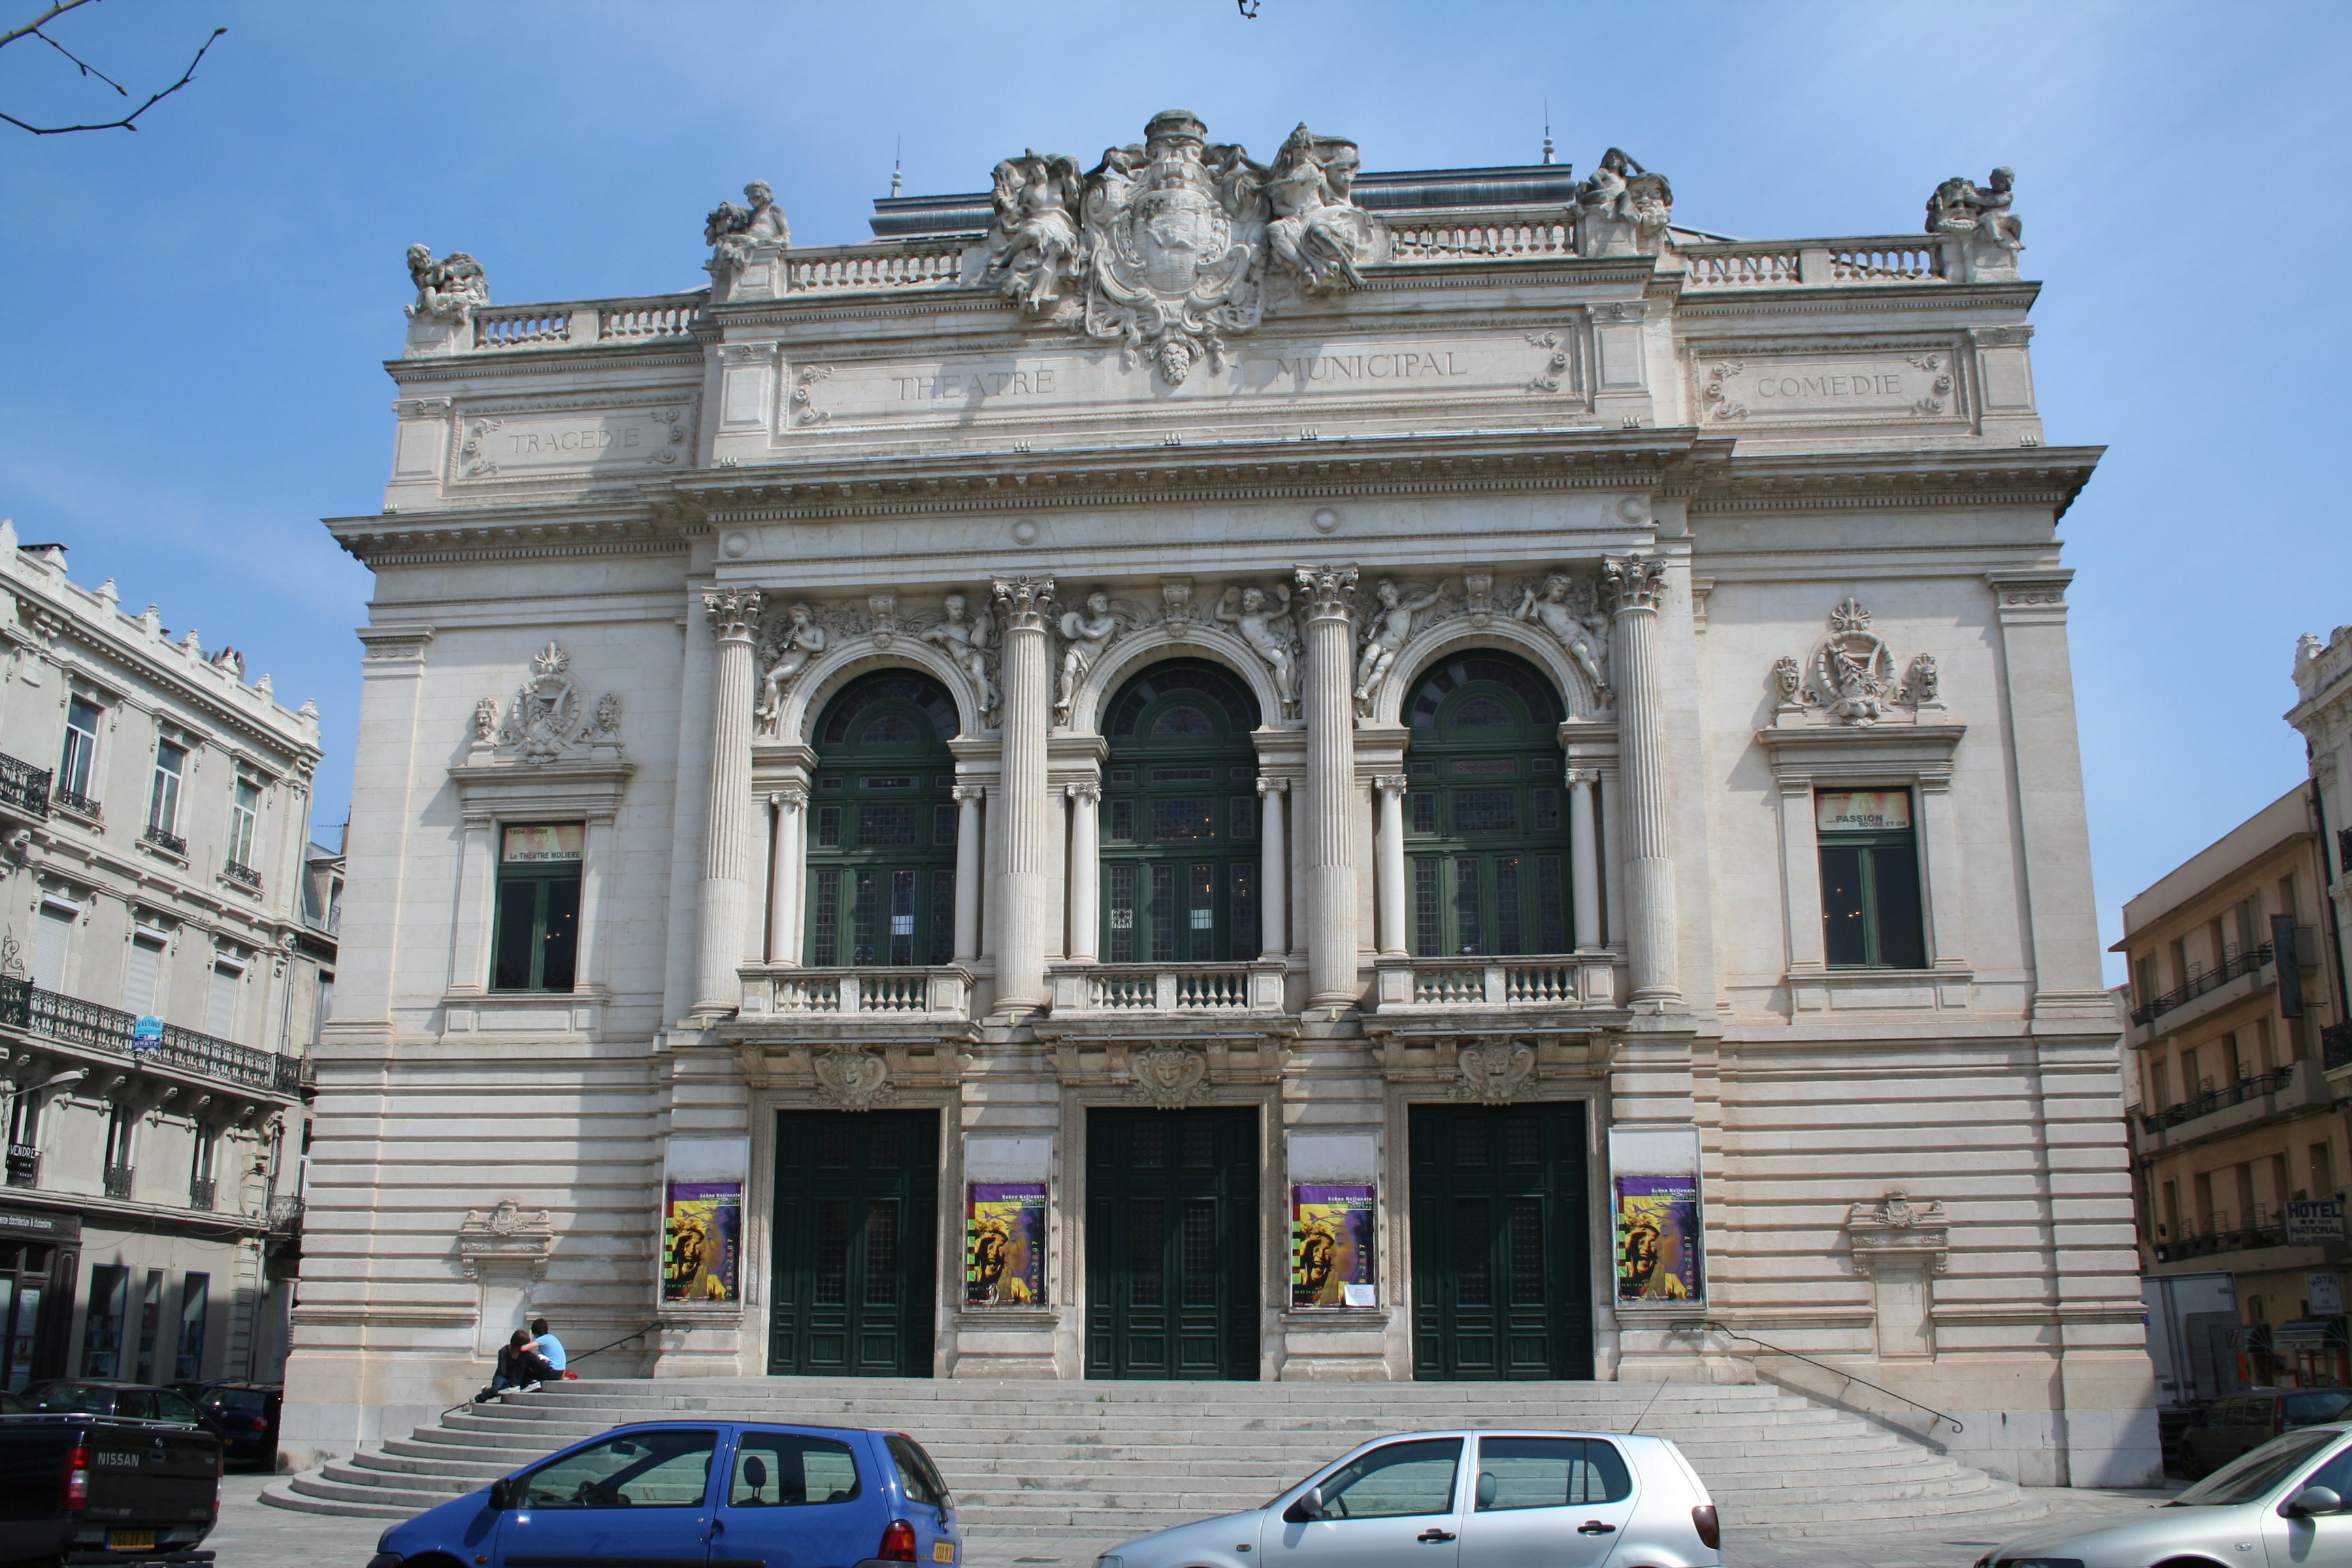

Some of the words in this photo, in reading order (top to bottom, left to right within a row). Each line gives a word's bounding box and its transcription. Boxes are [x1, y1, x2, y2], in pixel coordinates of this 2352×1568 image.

[892, 370, 1056, 400] THEATRE
[1275, 351, 1468, 382] MUNICIPAL
[1757, 374, 1902, 398] COMEDIE
[508, 427, 641, 453] TRAGEDIE
[2288, 1202, 2342, 1218] HOTEL
[2290, 1226, 2343, 1234] NATIONAL
[98, 1452, 139, 1467] NISSAN
